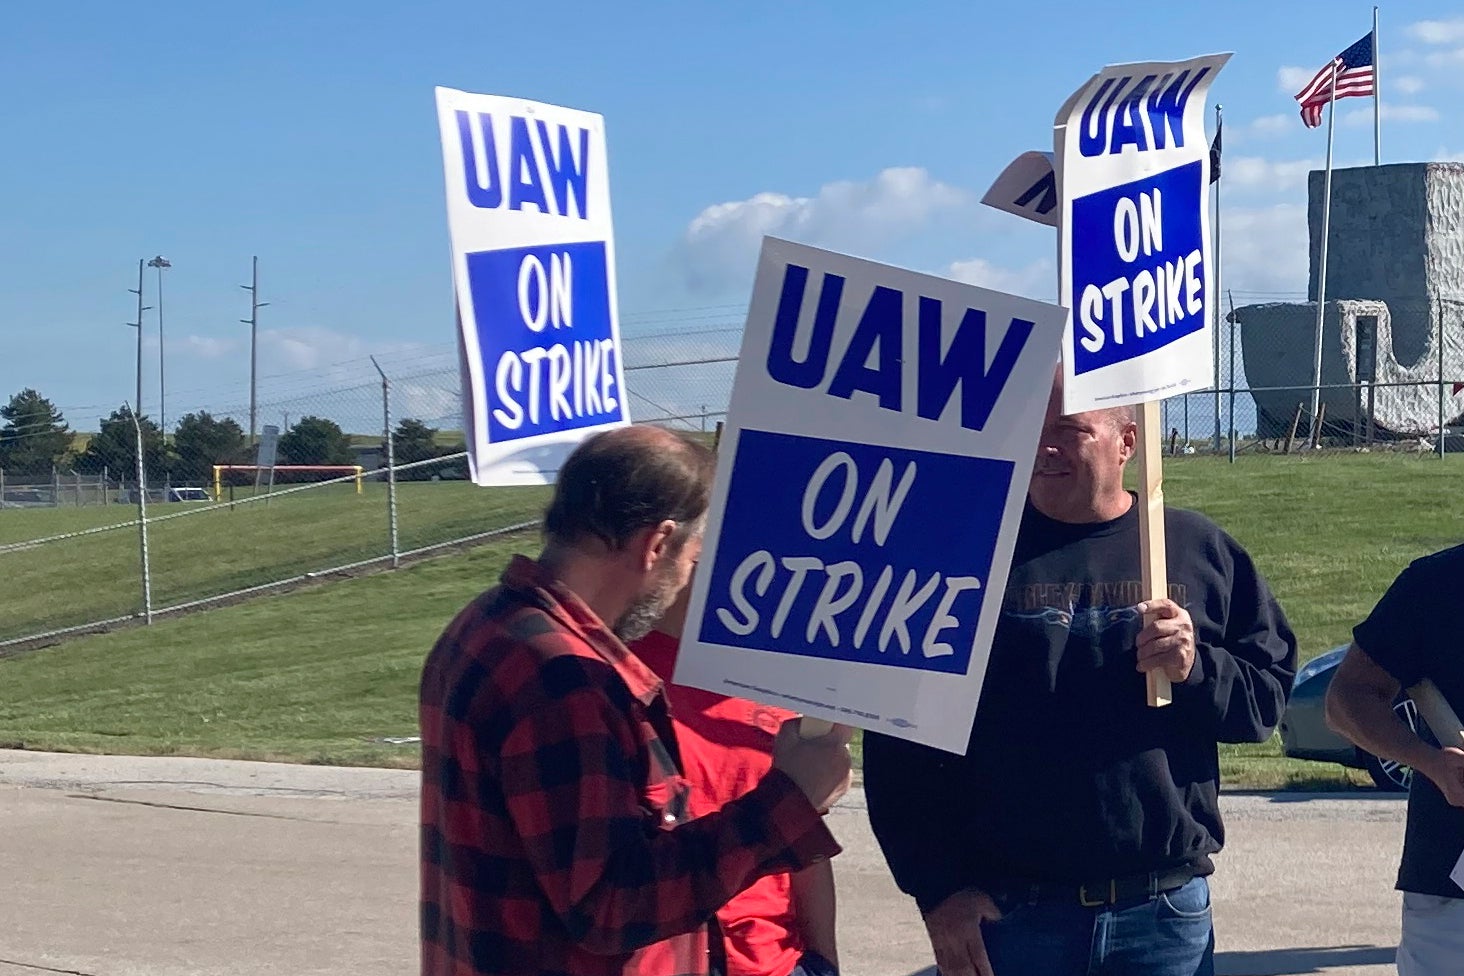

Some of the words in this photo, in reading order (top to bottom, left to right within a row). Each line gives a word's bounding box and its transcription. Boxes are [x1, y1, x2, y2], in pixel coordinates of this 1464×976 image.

[1079, 66, 1212, 158] UAW
[454, 110, 590, 220] UAW
[1113, 187, 1163, 263] ON
[517, 251, 574, 333] ON
[1079, 249, 1203, 353] STRIKE
[492, 338, 618, 430] STRIKE
[766, 263, 1036, 432] UAW
[801, 451, 918, 547] ON
[716, 550, 981, 659] STRIKE
